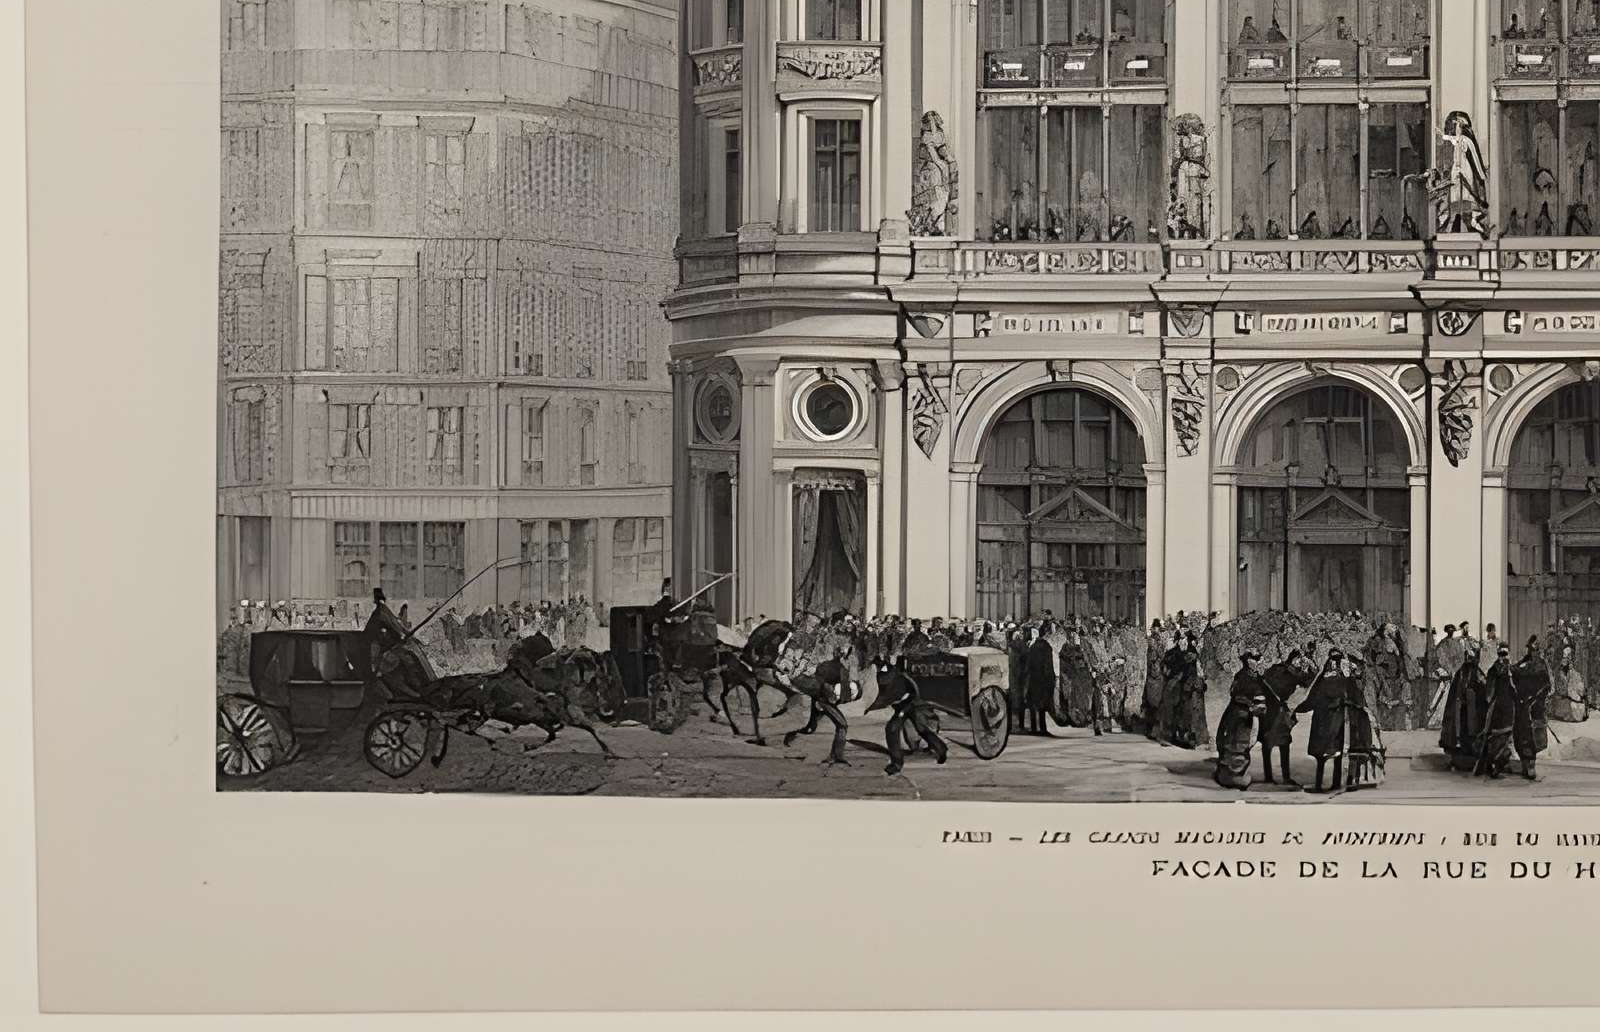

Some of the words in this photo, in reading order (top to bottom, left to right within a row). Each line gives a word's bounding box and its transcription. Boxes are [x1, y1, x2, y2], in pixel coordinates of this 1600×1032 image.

[1299, 860, 1339, 879] DE
[1361, 860, 1398, 879] LA
[1422, 860, 1488, 879] RUE
[1509, 861, 1552, 879] DU
